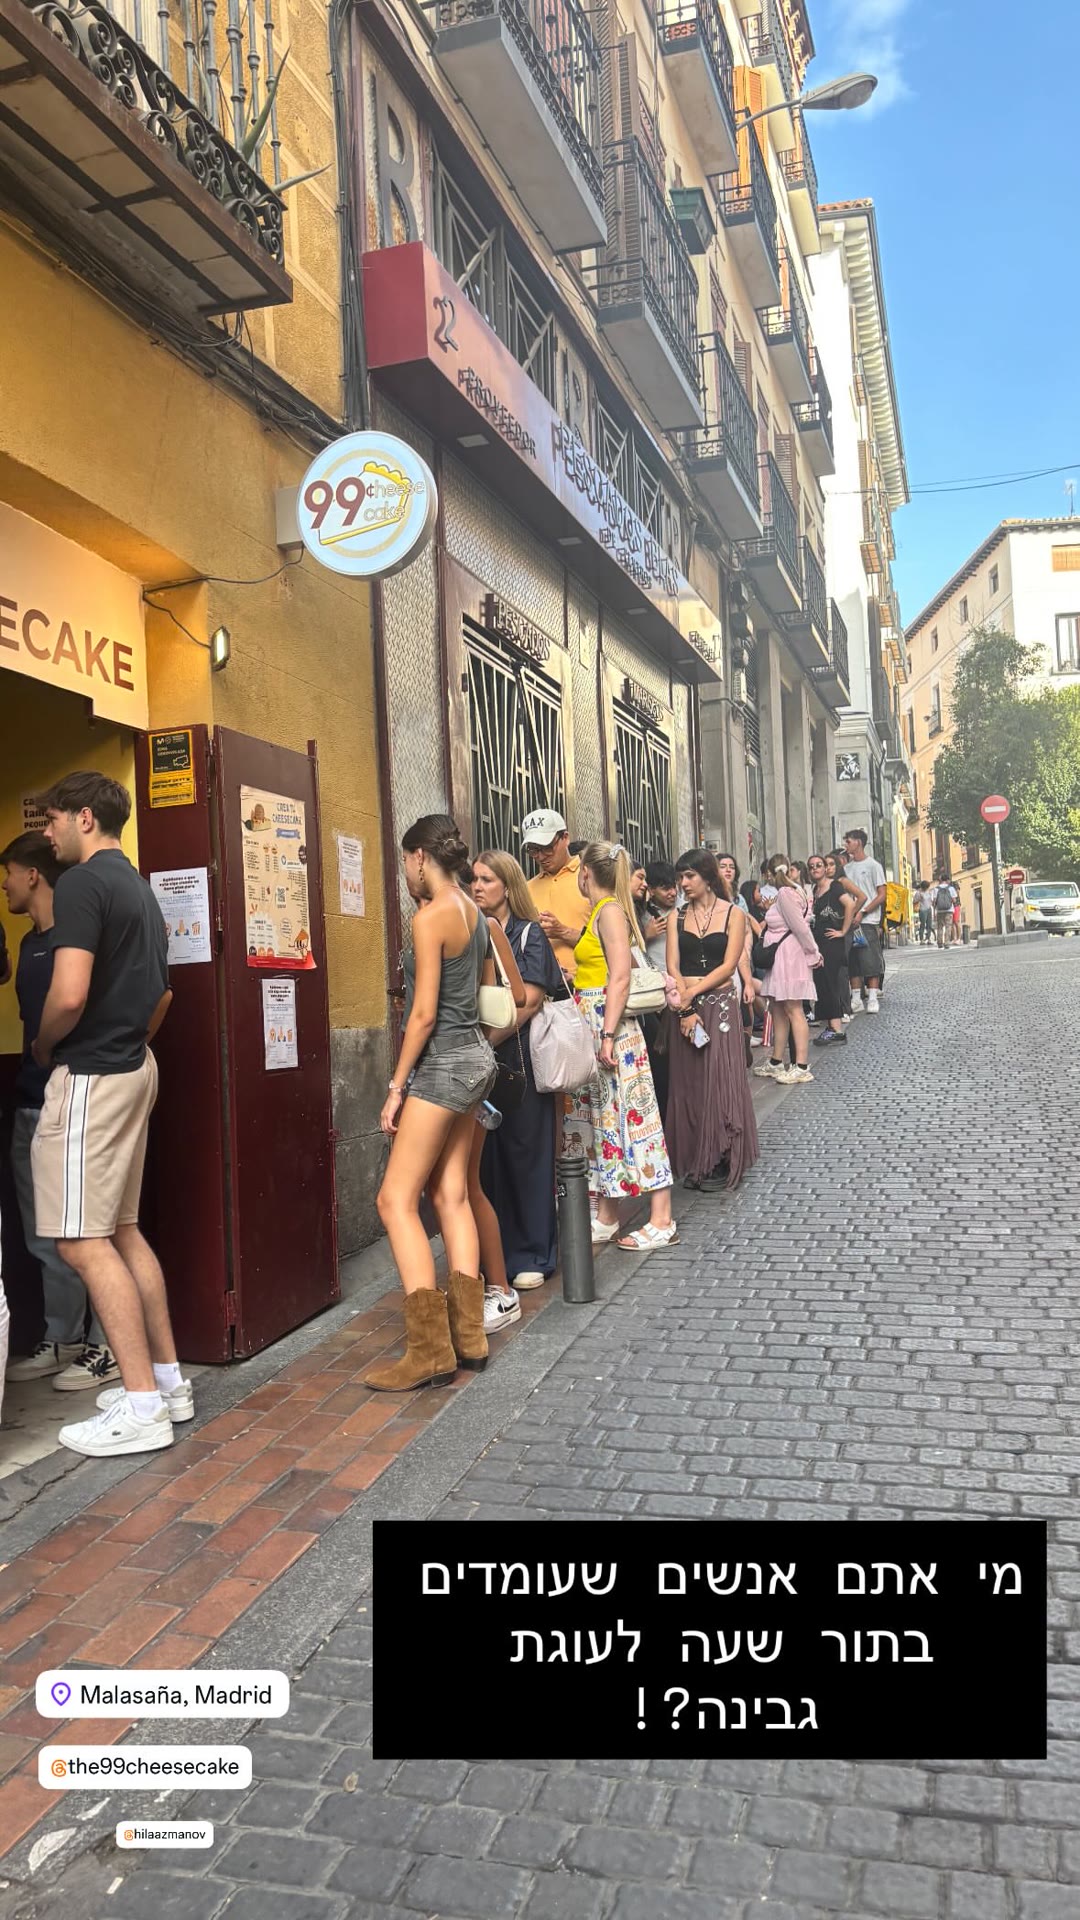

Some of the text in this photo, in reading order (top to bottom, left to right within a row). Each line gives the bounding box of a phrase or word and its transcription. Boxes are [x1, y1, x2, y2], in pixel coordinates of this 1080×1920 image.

[459, 366, 537, 459] PROVEEDOR
[304, 476, 365, 529] 99
[363, 501, 405, 521] cake
[0, 595, 134, 691] ECAKE
[525, 817, 545, 830] LAX
